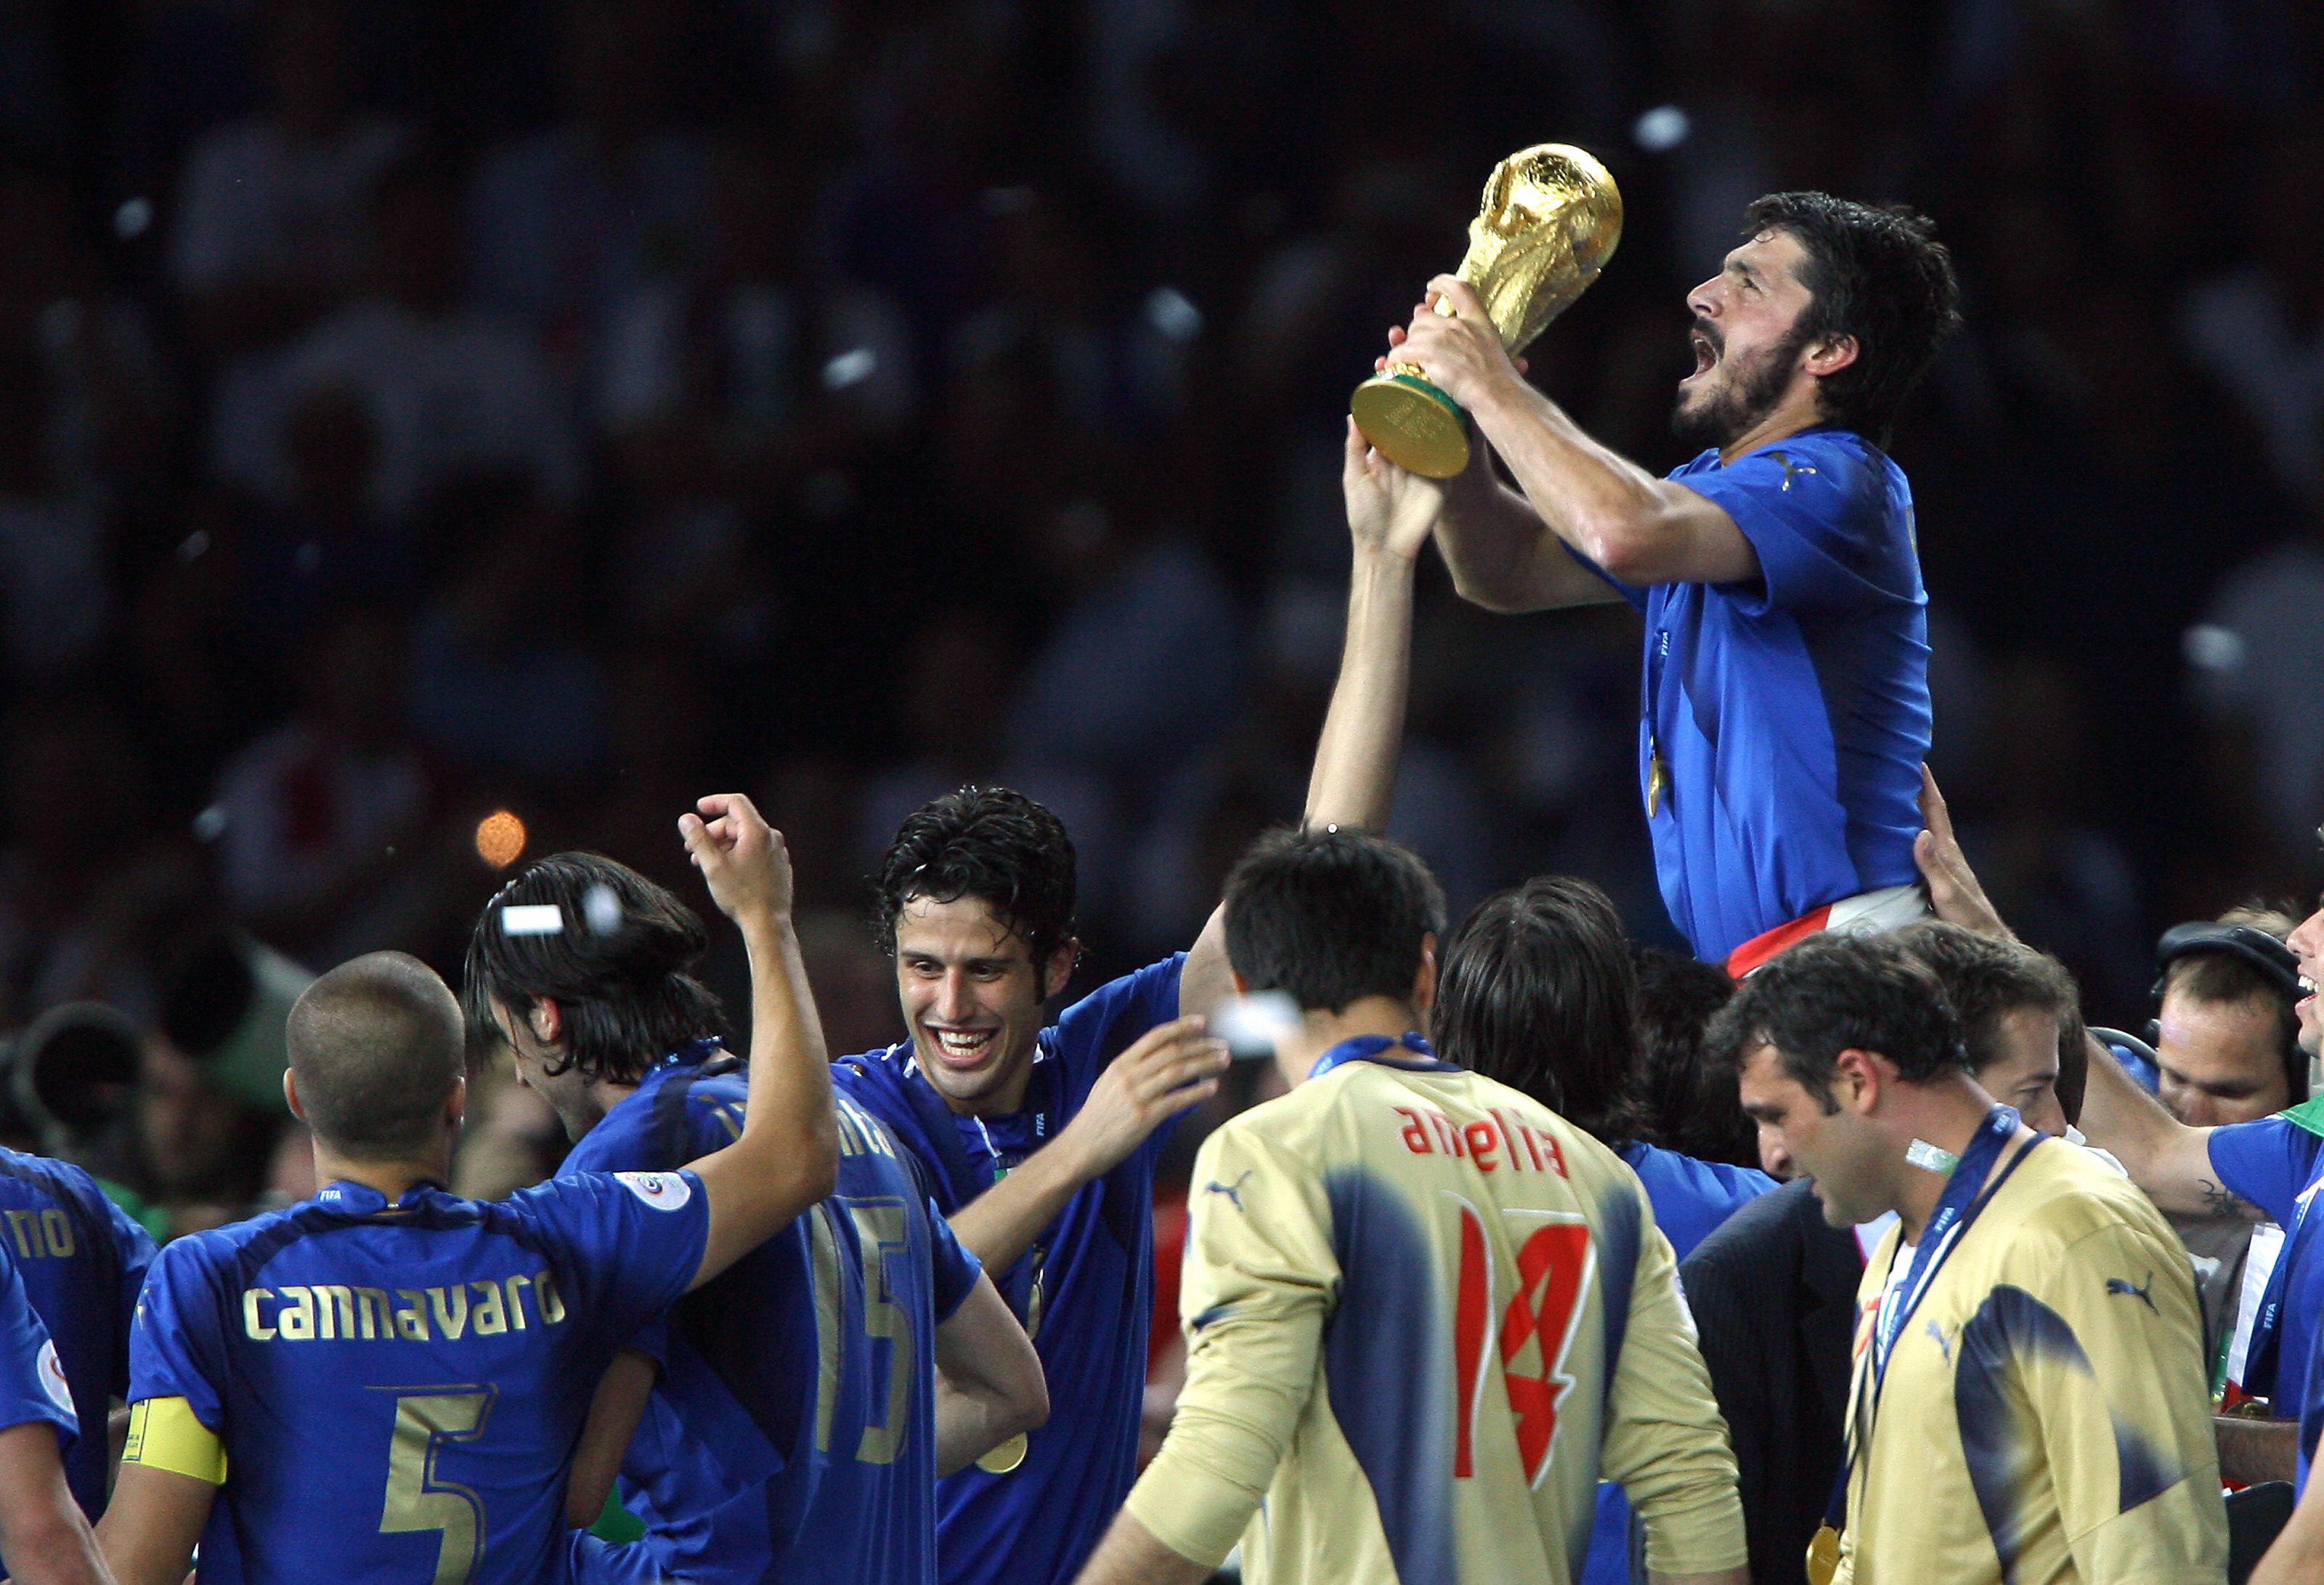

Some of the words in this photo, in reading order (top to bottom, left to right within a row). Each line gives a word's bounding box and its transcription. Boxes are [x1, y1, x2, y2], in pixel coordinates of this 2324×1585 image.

[1933, 1207, 1956, 1233] FIFA
[242, 1270, 566, 1341] cannavaro
[809, 1195, 914, 1464] 15
[1441, 1190, 1598, 1491] 14
[2263, 1302, 2276, 1329] FIFA
[365, 1383, 499, 1585] 5
